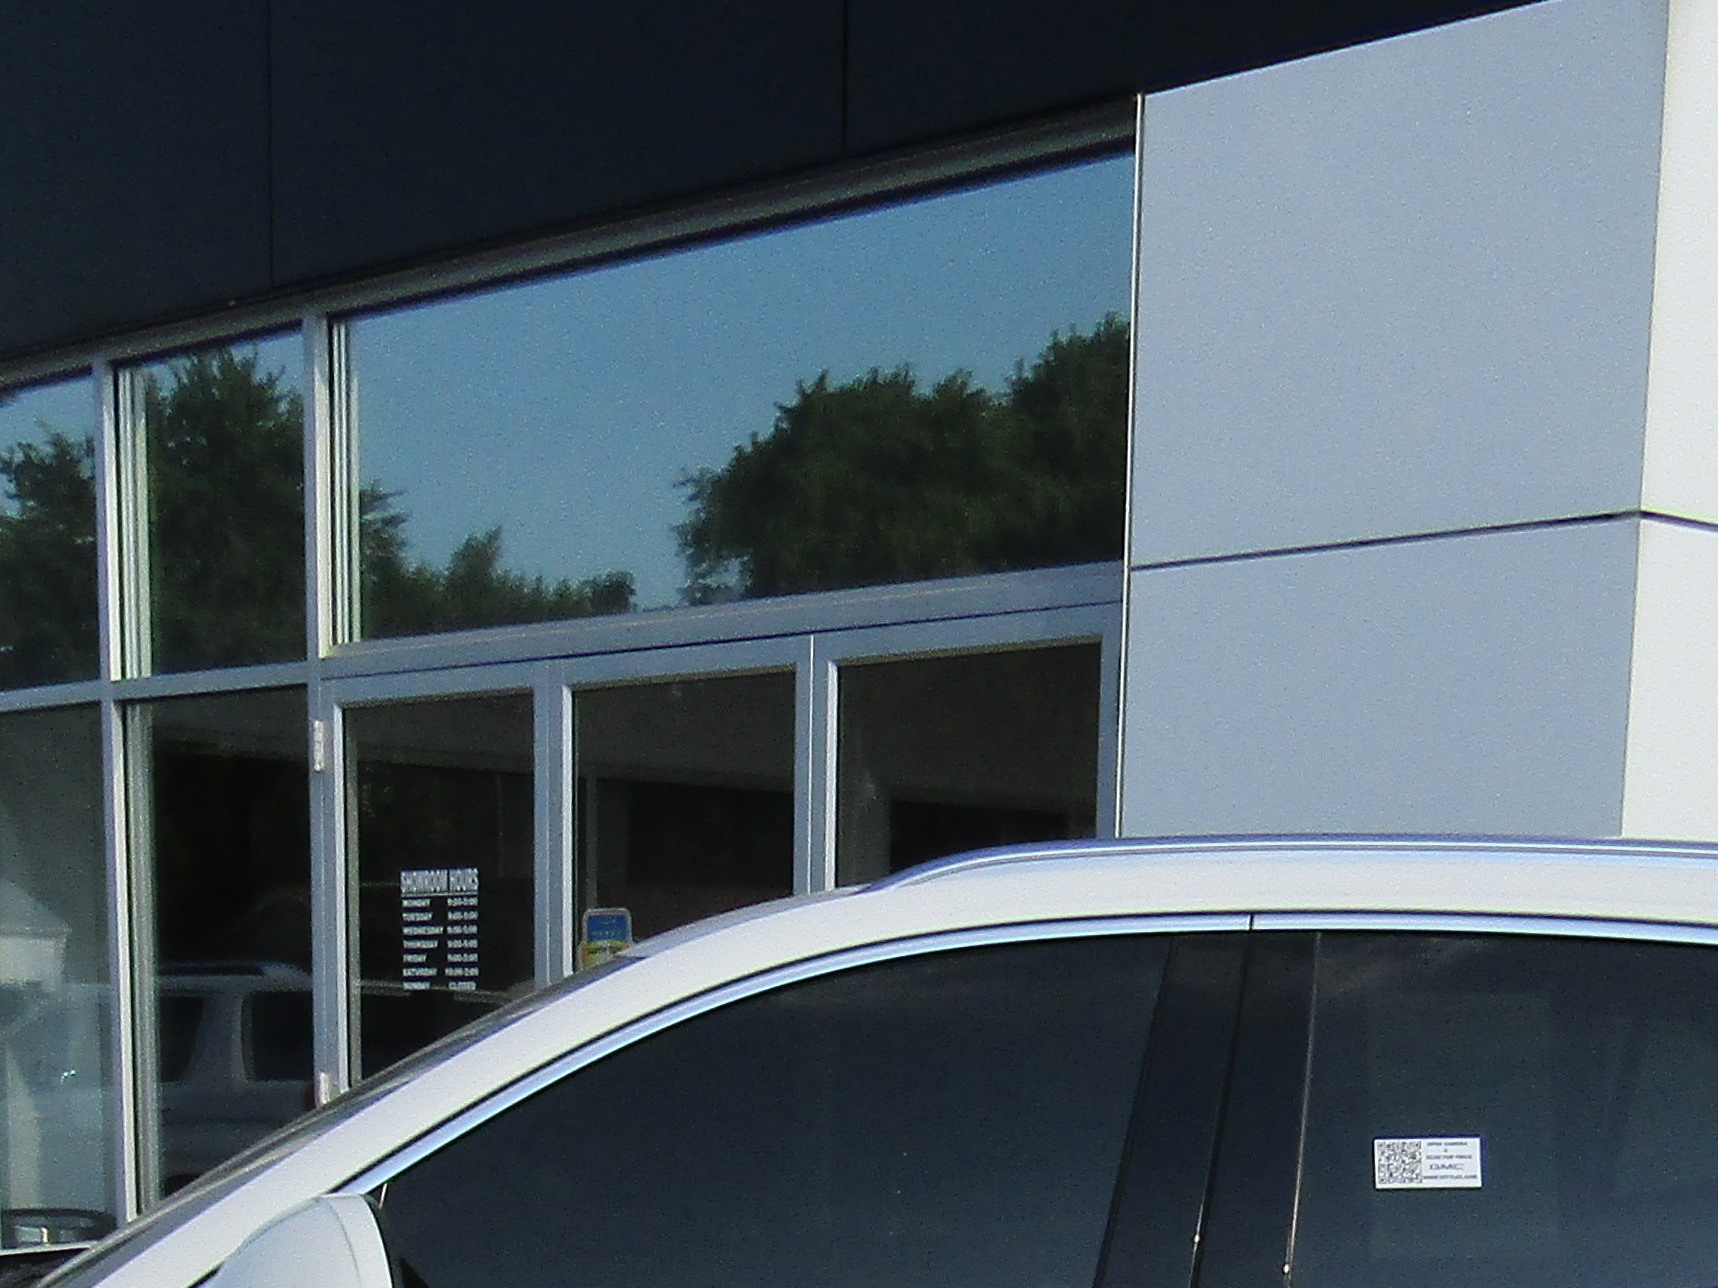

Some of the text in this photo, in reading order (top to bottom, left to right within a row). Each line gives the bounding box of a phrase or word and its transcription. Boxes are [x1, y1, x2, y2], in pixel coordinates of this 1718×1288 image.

[400, 867, 479, 893] SHOWROOM HOURS
[401, 898, 431, 908] MONDAY
[401, 911, 434, 922] TUESDAY
[402, 926, 444, 936] WEDNESDAY
[402, 939, 439, 949] THURSDAY
[402, 953, 428, 963] FRIDAY
[402, 967, 438, 977] SATURDAY
[402, 980, 477, 991] SUNDAY CLOSED
[1429, 1162, 1464, 1170] GMC
